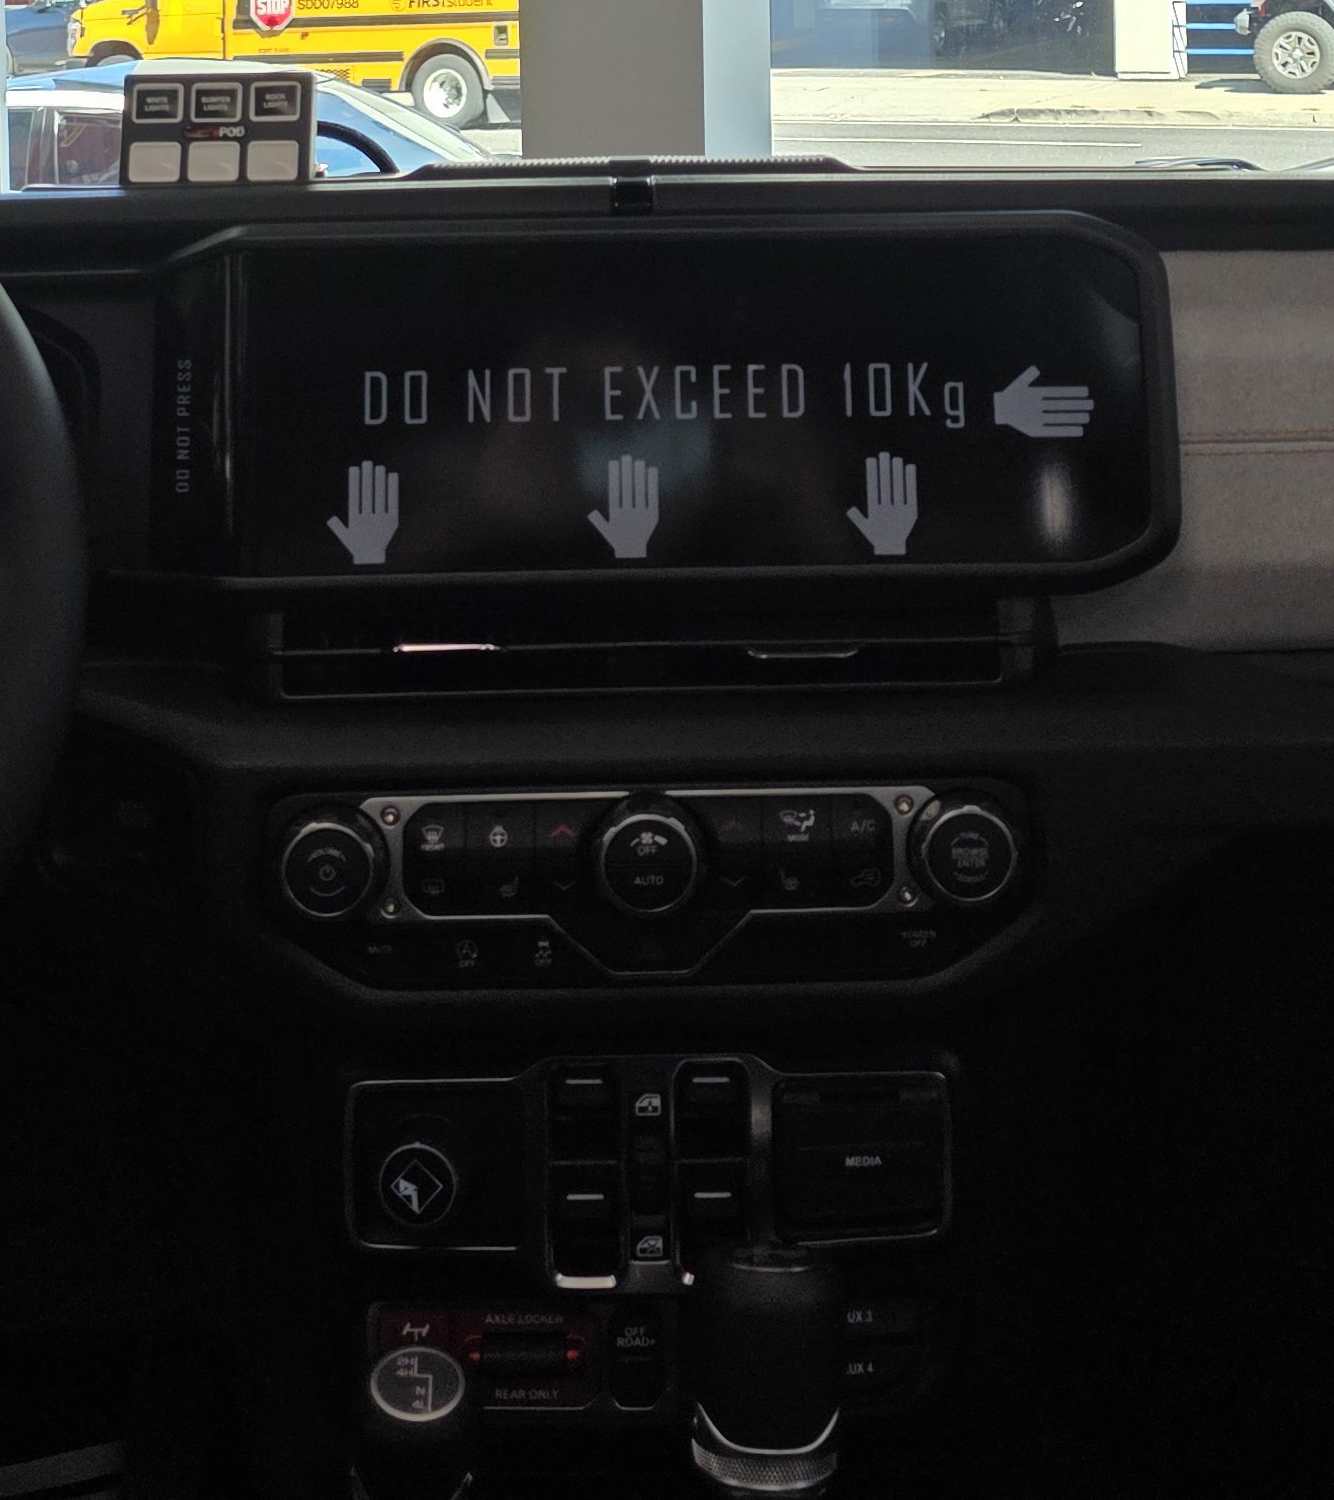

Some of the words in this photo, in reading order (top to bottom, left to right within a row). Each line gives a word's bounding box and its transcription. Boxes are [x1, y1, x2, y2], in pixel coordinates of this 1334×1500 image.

[176, 359, 193, 417] PRESS
[364, 369, 428, 425] DO
[467, 367, 567, 423] NOT
[603, 365, 805, 420] EXCEED
[843, 362, 966, 428] 10Kg
[175, 427, 191, 460] NOT
[175, 470, 191, 493] DO
[849, 819, 876, 834] A/C
[637, 845, 658, 856] OFF
[634, 875, 664, 886] AUTO
[844, 1155, 883, 1168] MEDIA
[484, 1313, 515, 1325] AXLE
[517, 1313, 564, 1325] LOCKER
[847, 1310, 863, 1323] UX
[866, 1309, 873, 1323] 3
[624, 1327, 645, 1336] OFF
[847, 1362, 864, 1375] UX
[866, 1361, 874, 1373] 4
[494, 1388, 527, 1400] REAR
[527, 1388, 560, 1400] ONLY
